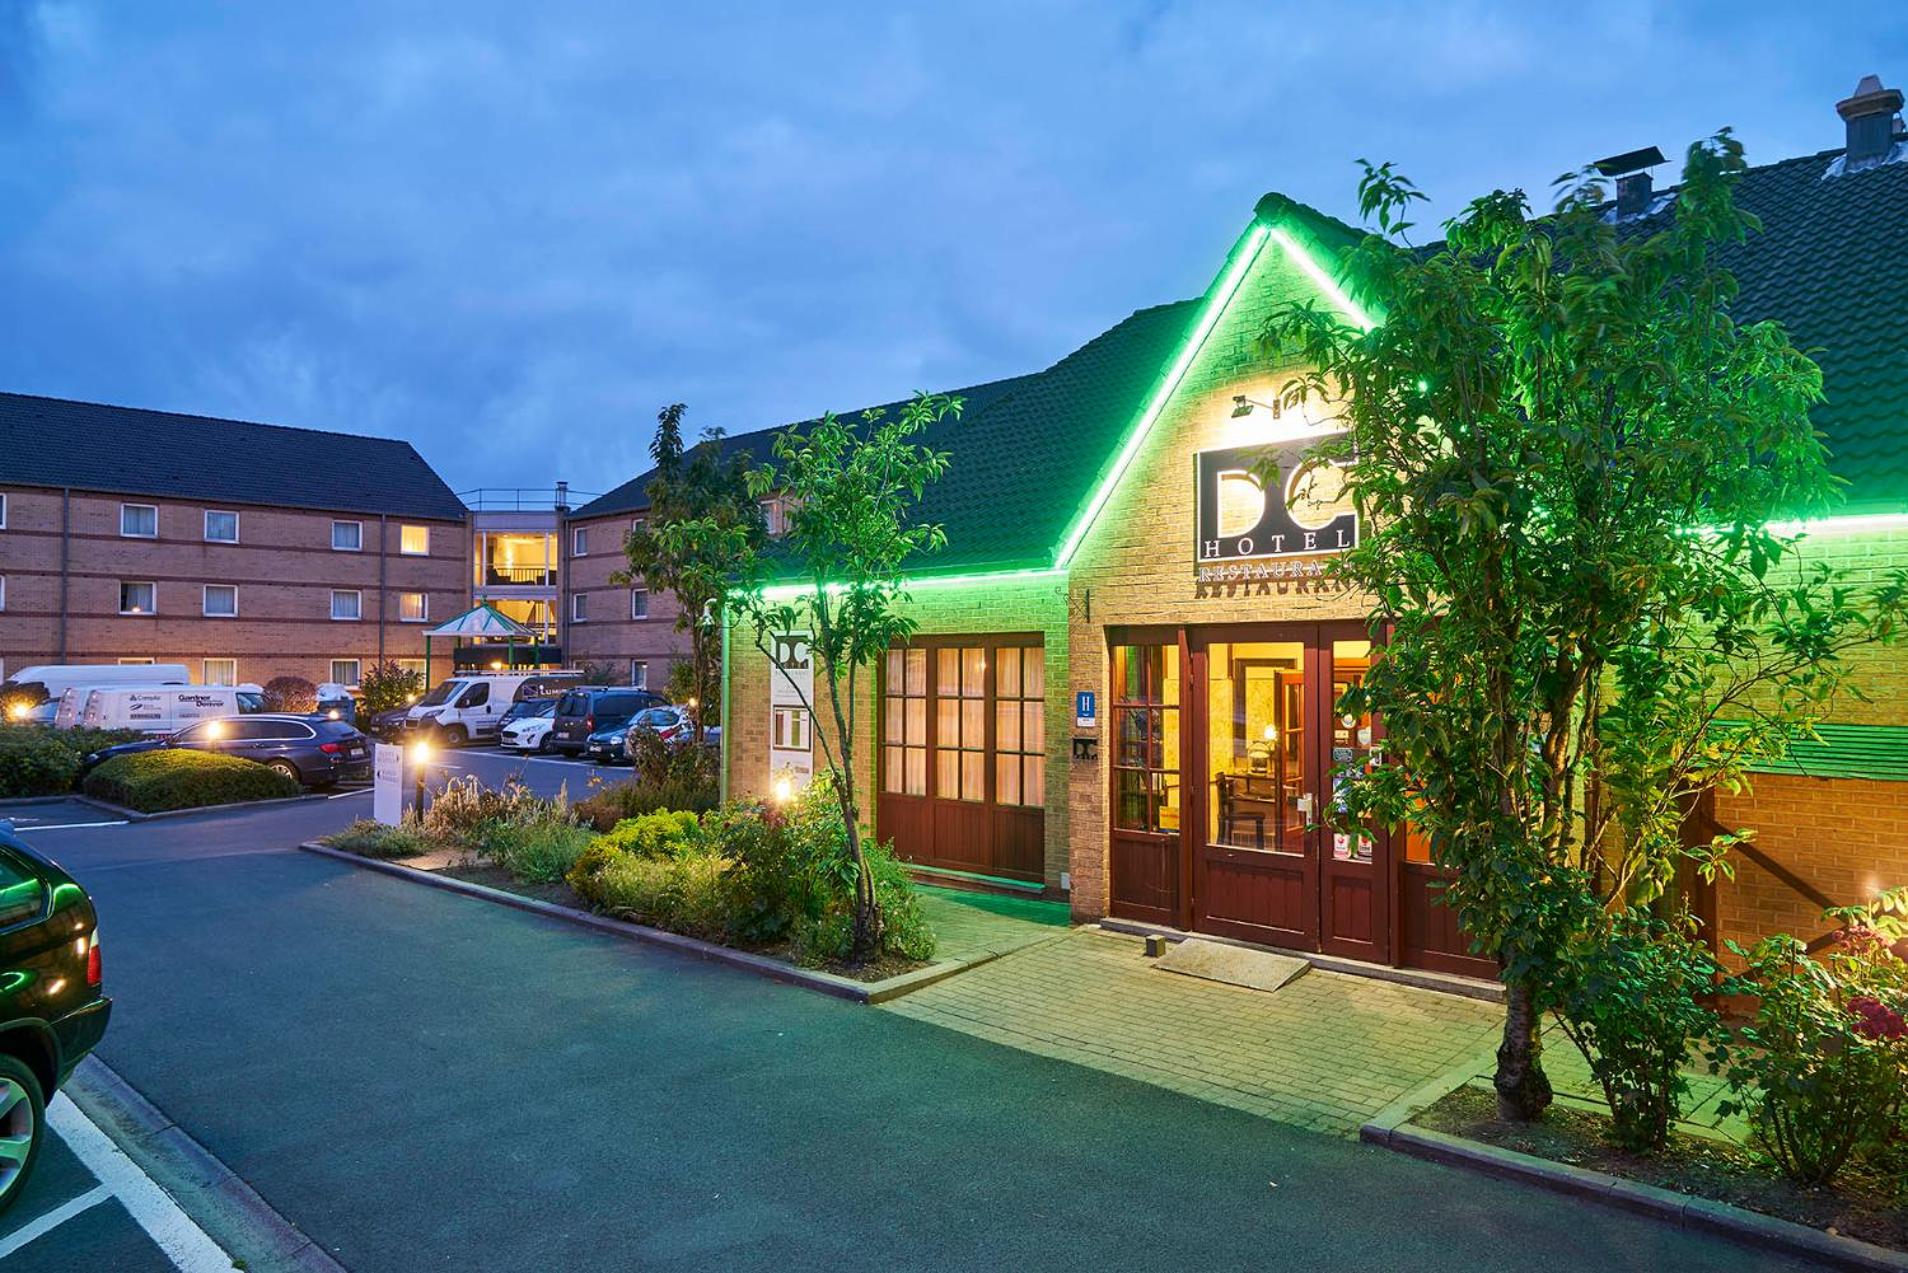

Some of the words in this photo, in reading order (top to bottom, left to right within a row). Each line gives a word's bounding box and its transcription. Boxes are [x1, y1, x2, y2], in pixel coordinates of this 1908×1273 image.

[1204, 529, 1350, 558] HOTEL
[1199, 559, 1351, 583] RESTAURA
[195, 700, 224, 708] Denver
